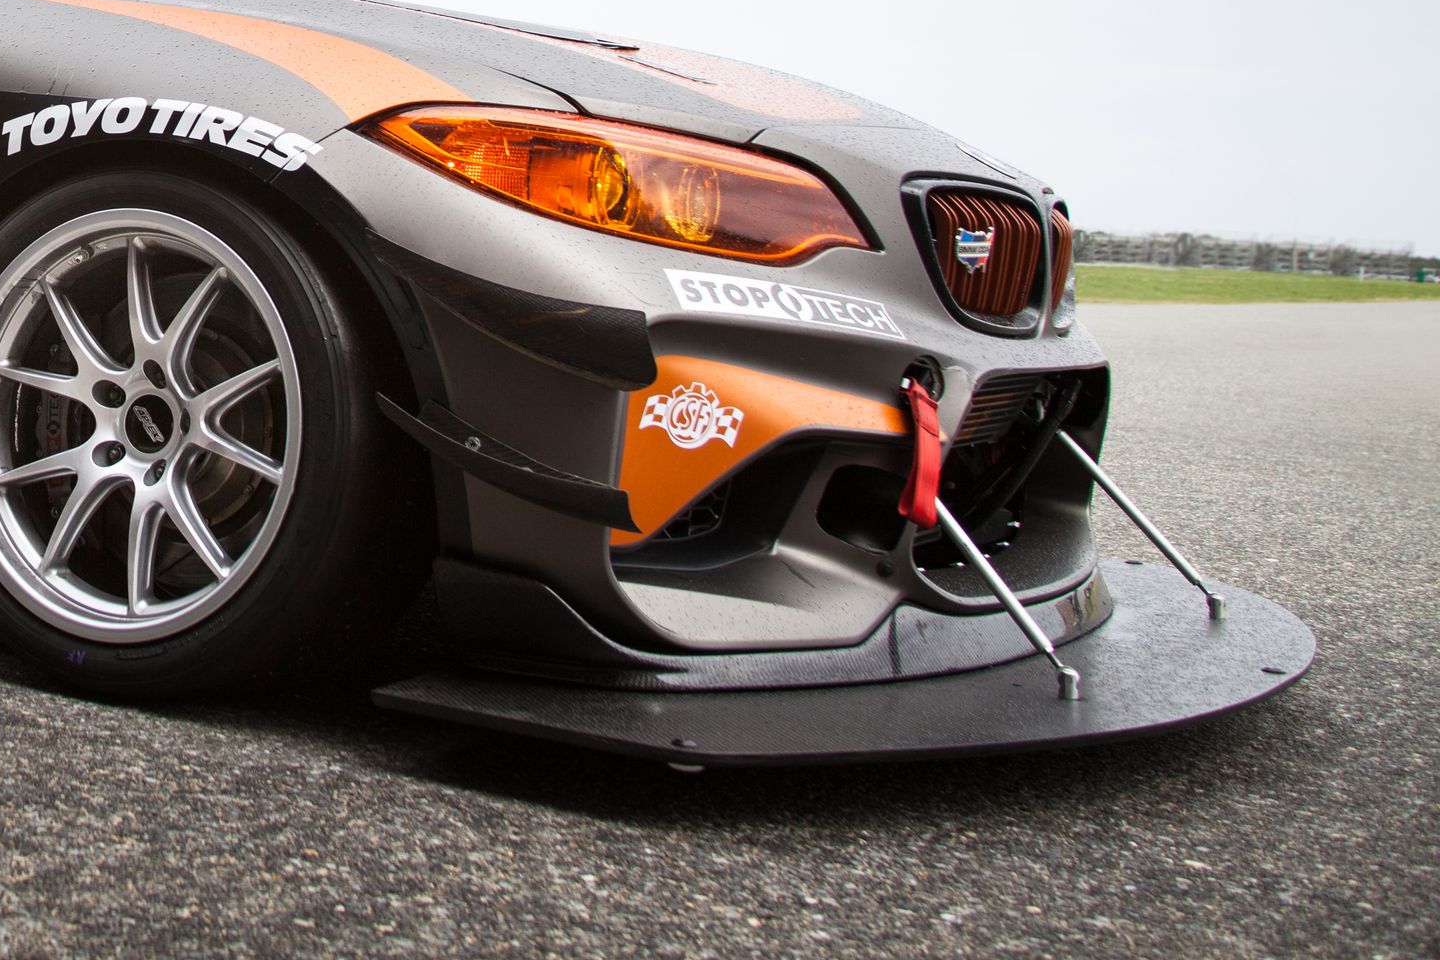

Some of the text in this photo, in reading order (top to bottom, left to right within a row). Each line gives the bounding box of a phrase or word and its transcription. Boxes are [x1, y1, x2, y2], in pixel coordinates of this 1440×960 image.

[1, 96, 324, 172] TOYO TIRES
[134, 406, 162, 441] APEX
[669, 398, 711, 438] CSF
